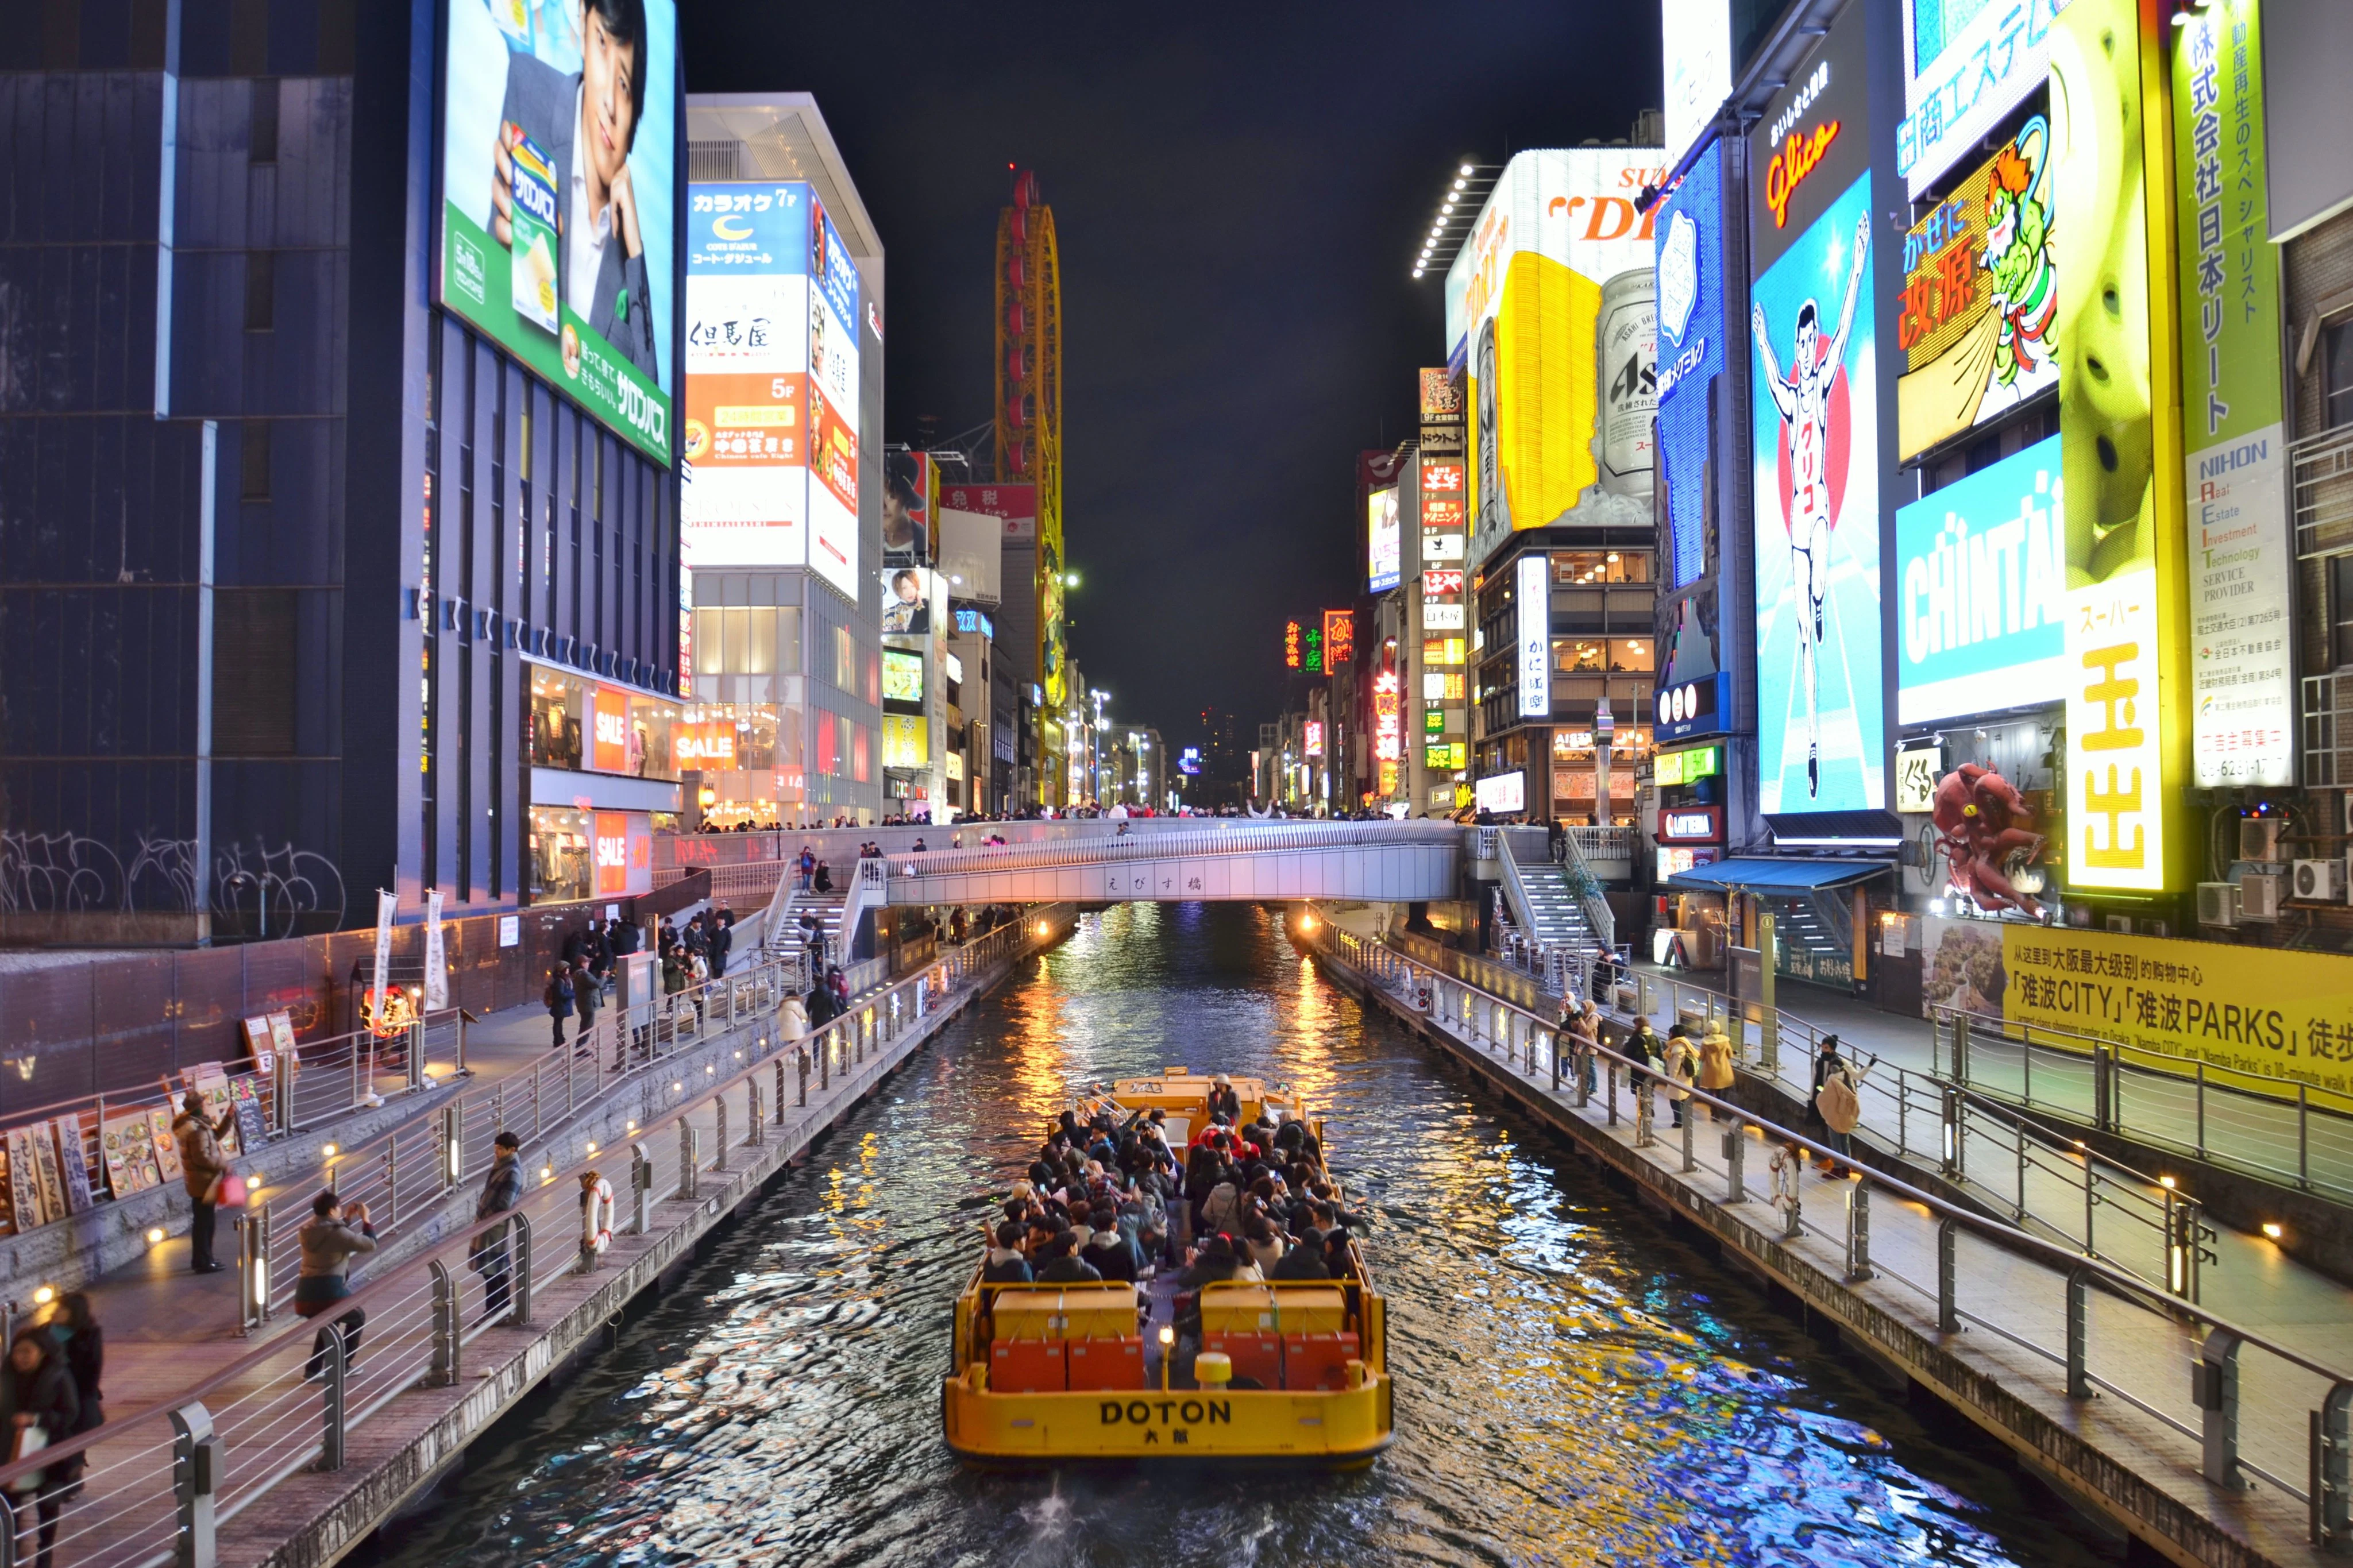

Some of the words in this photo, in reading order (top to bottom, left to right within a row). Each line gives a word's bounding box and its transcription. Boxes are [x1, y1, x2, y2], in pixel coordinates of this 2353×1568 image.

[1766, 120, 1839, 229] Glico
[515, 166, 557, 230] サロンパス
[693, 194, 773, 213] カラオケ
[776, 188, 797, 207] 7F
[1903, 200, 1965, 273] かぜに
[2190, 21, 2229, 437] 株式会社日本リート
[1897, 236, 1973, 351] 改源
[689, 317, 772, 347] 但馬屋
[1622, 322, 1639, 342] ASAHI
[1641, 313, 1657, 326] BRE
[772, 378, 795, 398] 5F
[616, 369, 667, 449] サロンパス
[1424, 413, 1434, 422] 9F
[1802, 413, 1814, 515] グリコ
[2200, 439, 2267, 480] NIHON
[2201, 481, 2230, 503] Real
[2201, 504, 2240, 526] Estate
[1424, 527, 1438, 535] 6F
[2202, 523, 2258, 548] Investment
[1431, 562, 1442, 570] 5F
[2201, 547, 2260, 569] Technology
[2203, 566, 2246, 588] SERVICE
[2204, 580, 2255, 603] PROVIDER
[1426, 700, 1440, 708] 1F
[596, 711, 624, 746] SALE
[676, 737, 733, 758] SALE
[2081, 641, 2144, 870] 玉出
[1673, 815, 1710, 834] LOTTERIA
[597, 836, 625, 867] SALE
[1108, 877, 1202, 891] えびす橋
[2014, 944, 2203, 987] 从这里到大阪最大级别的购物中心
[2185, 1046, 2199, 1060] and
[2263, 1059, 2273, 1076] is
[2274, 1061, 2321, 1087] 10-minute
[2323, 1073, 2348, 1094] walk
[1100, 1400, 1231, 1425] DOTON
